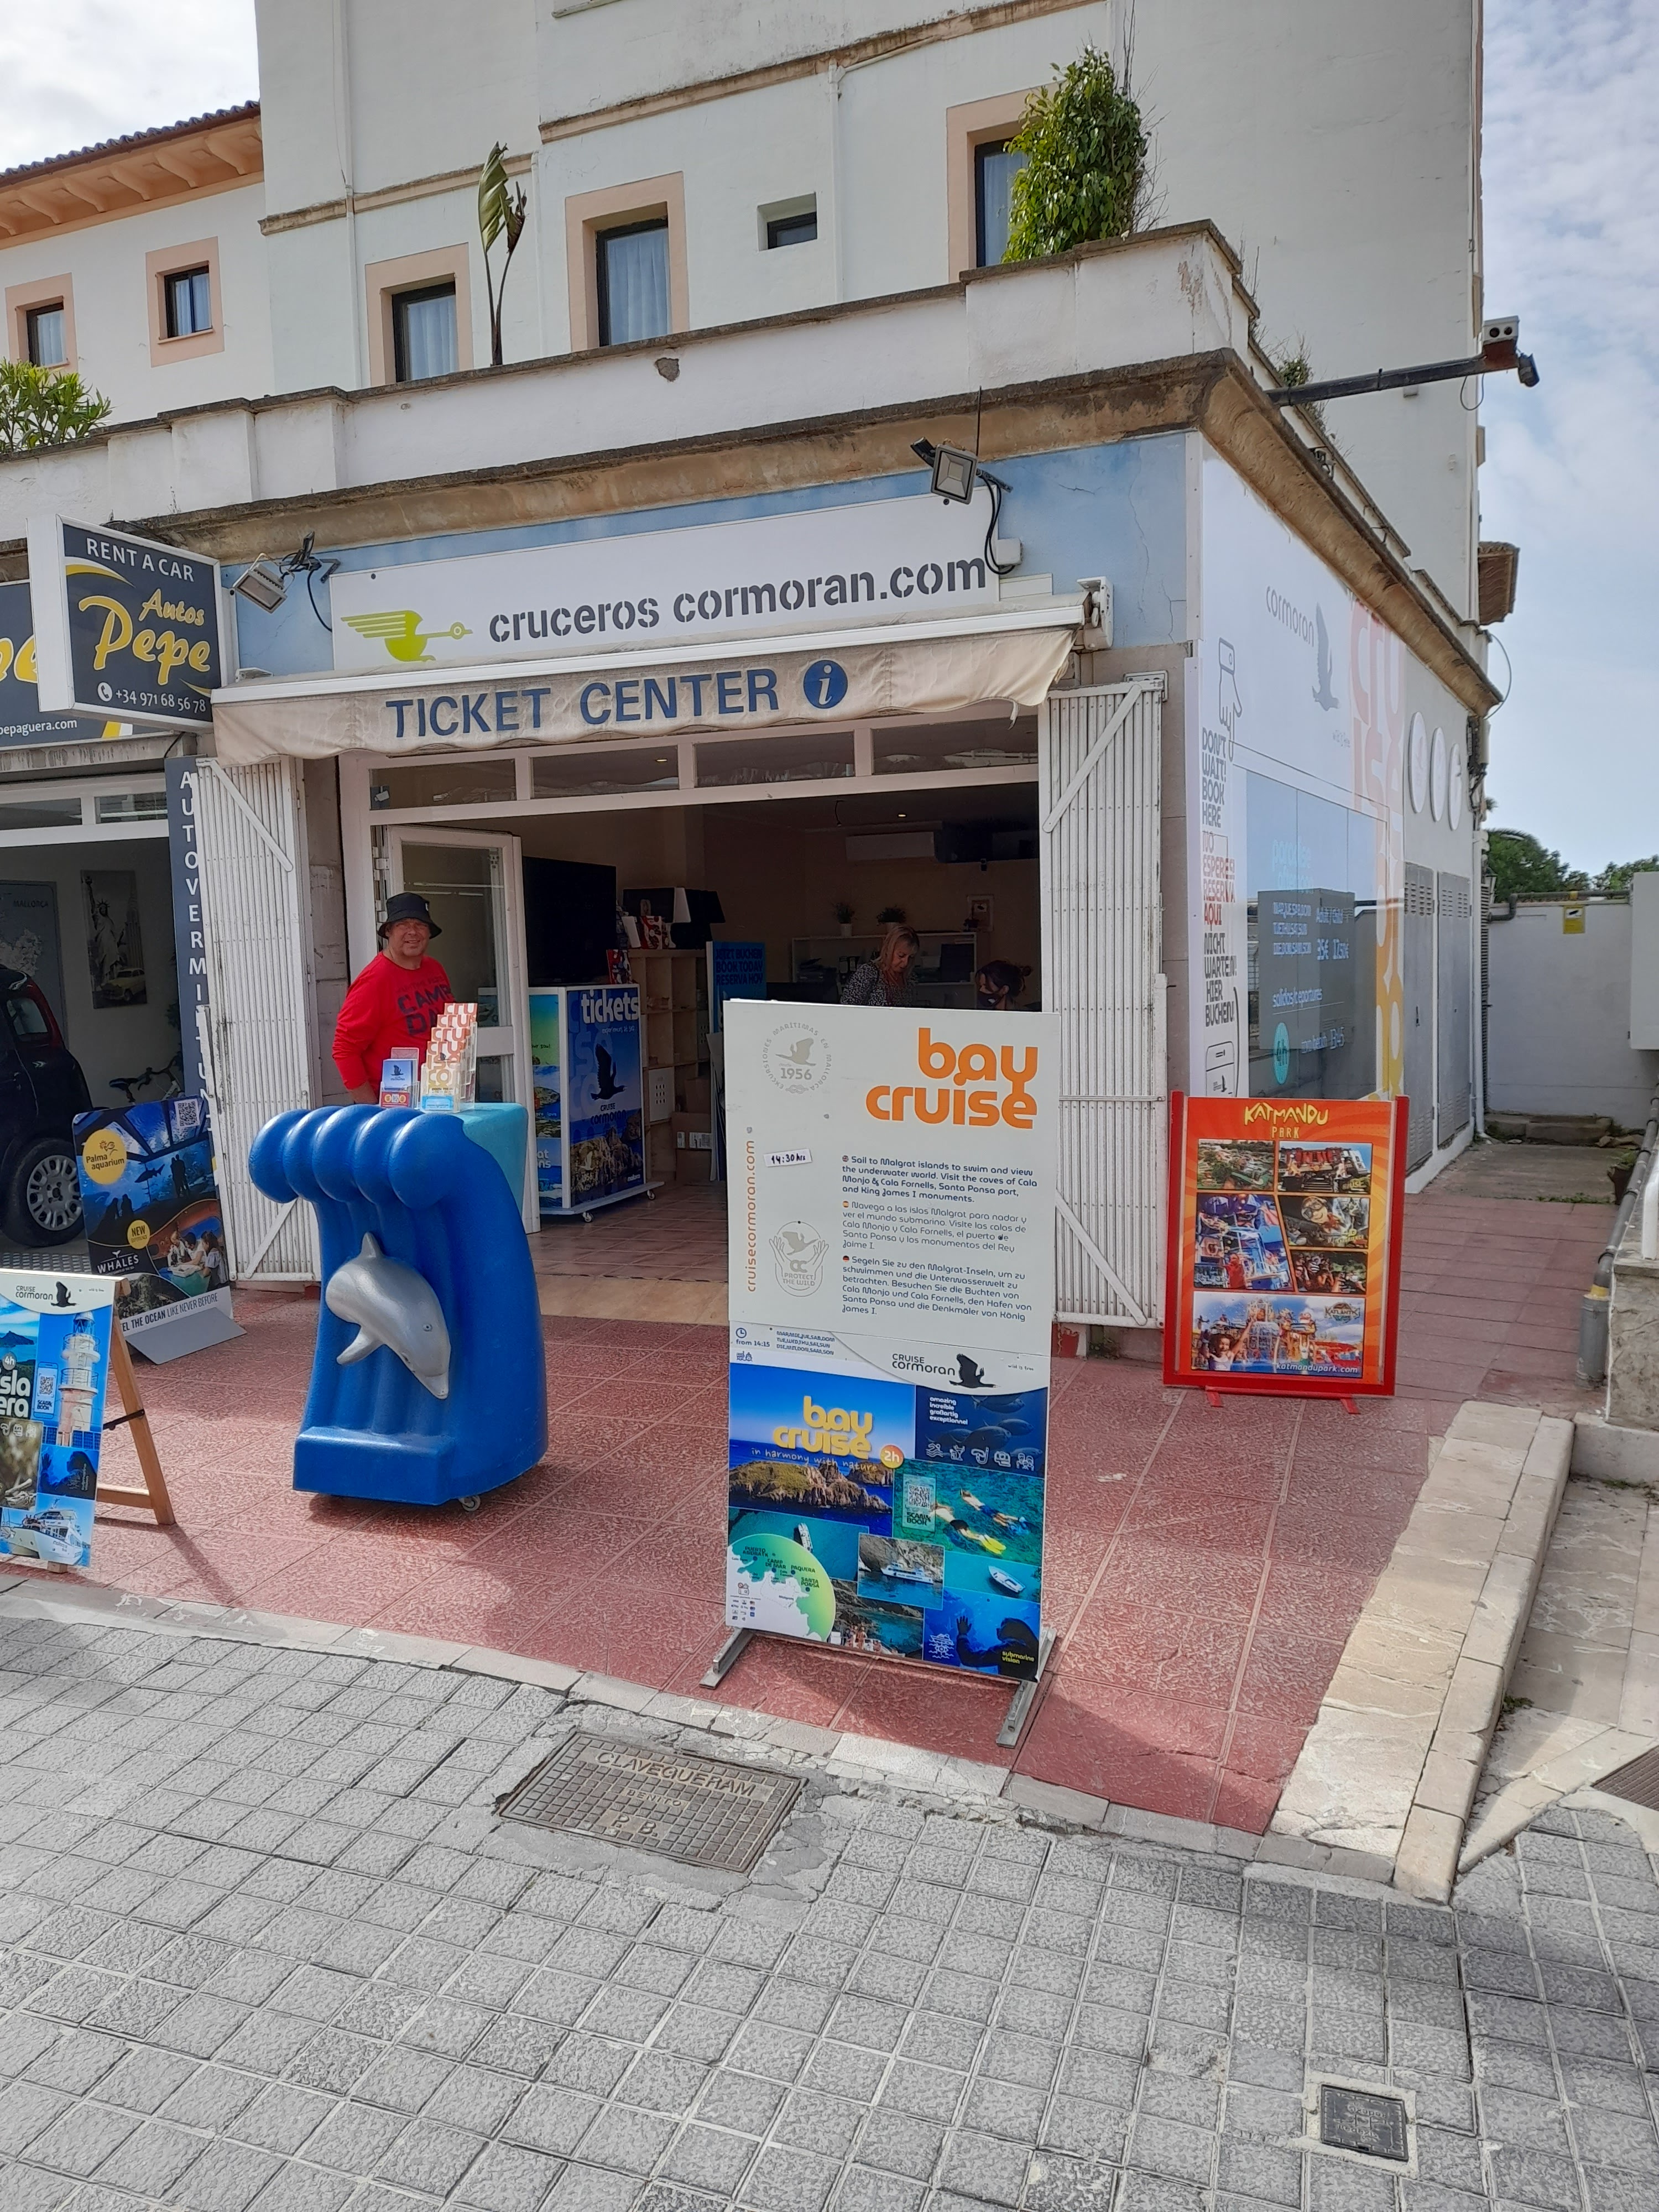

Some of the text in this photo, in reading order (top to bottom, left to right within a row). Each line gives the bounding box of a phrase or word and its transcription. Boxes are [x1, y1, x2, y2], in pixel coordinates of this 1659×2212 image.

[87, 537, 194, 583] RENT A CAR
[137, 588, 206, 627] Autos
[489, 555, 987, 644] cruceros cormoran.com
[1265, 585, 1315, 648] cormoran
[78, 595, 211, 686] Pepe
[116, 688, 207, 713] +34 971 68 56 78
[385, 666, 779, 739] TICKET CENTER
[1202, 727, 1227, 759] DON'T
[1202, 752, 1227, 782] WAIT!
[1202, 776, 1225, 806] BOOK
[1202, 802, 1222, 828] HERE
[1204, 932, 1225, 955] NICHT
[716, 961, 763, 973] BOOK TODAY
[1204, 955, 1237, 979] WARTEN!
[716, 973, 763, 985] RESERVA HOY
[1206, 979, 1223, 1003] HIER
[581, 989, 639, 1024] tickets
[1206, 1001, 1235, 1027] BUCHEN!
[820, 1038, 830, 1049] EN
[762, 1037, 784, 1089] EXCURSIONES
[918, 1027, 1038, 1093] bay
[780, 1067, 812, 1081] 1956
[809, 1053, 832, 1091] MALLORCA
[865, 1085, 1037, 1129] cruise
[1244, 1102, 1329, 1126] KATMANDU
[1272, 1126, 1300, 1139] PARK
[86, 1154, 108, 1164] Palma
[91, 1157, 125, 1171] aquarium
[771, 1153, 795, 1164] 14:30
[880, 1159, 915, 1168] Malgrat
[919, 1161, 949, 1170] islands
[1011, 1168, 1032, 1177] view
[859, 1167, 909, 1177] underwater
[843, 1175, 870, 1185] Monjo
[872, 1177, 879, 1186] &
[901, 1180, 936, 1190] Fornells,
[939, 1183, 965, 1191] Santa
[968, 1185, 995, 1193] Ponsa
[862, 1187, 880, 1196] King
[882, 1188, 910, 1197] James
[919, 1193, 974, 1202] monuments.
[746, 1140, 757, 1292] cruisecormoran.com
[131, 1225, 146, 1237] NEW
[97, 1254, 139, 1274] WHALES
[852, 1256, 879, 1266] Segeln
[928, 1264, 995, 1278] Malgrat-Inseln,
[843, 1266, 893, 1276] schwimmen
[930, 1274, 1005, 1287] Unterwasserwelt
[15, 1291, 54, 1301] cormoran
[131, 1292, 218, 1329] THE OCEAN LIKE NEVER BEFORE
[4, 1356, 15, 1366] 4h
[892, 1353, 925, 1364] CRUISE
[892, 1361, 956, 1376] cormoran
[1276, 1363, 1359, 1374] katmandupark.com
[929, 1396, 957, 1406] amazing
[804, 1395, 873, 1434] bay
[929, 1408, 959, 1418] großartig
[929, 1415, 968, 1425] exceptionnel
[773, 1426, 872, 1459] cruise
[765, 1448, 810, 1465] harmony
[813, 1457, 838, 1467] with
[842, 1460, 878, 1472] nature
[884, 1450, 900, 1463] 2h
[906, 1517, 927, 1526] BOOK
[1002, 1651, 1035, 1662] submarine
[1002, 1656, 1021, 1665] vision
[596, 1750, 756, 1797] CLAVEGUERAM
[626, 1788, 682, 1808] BENITO
